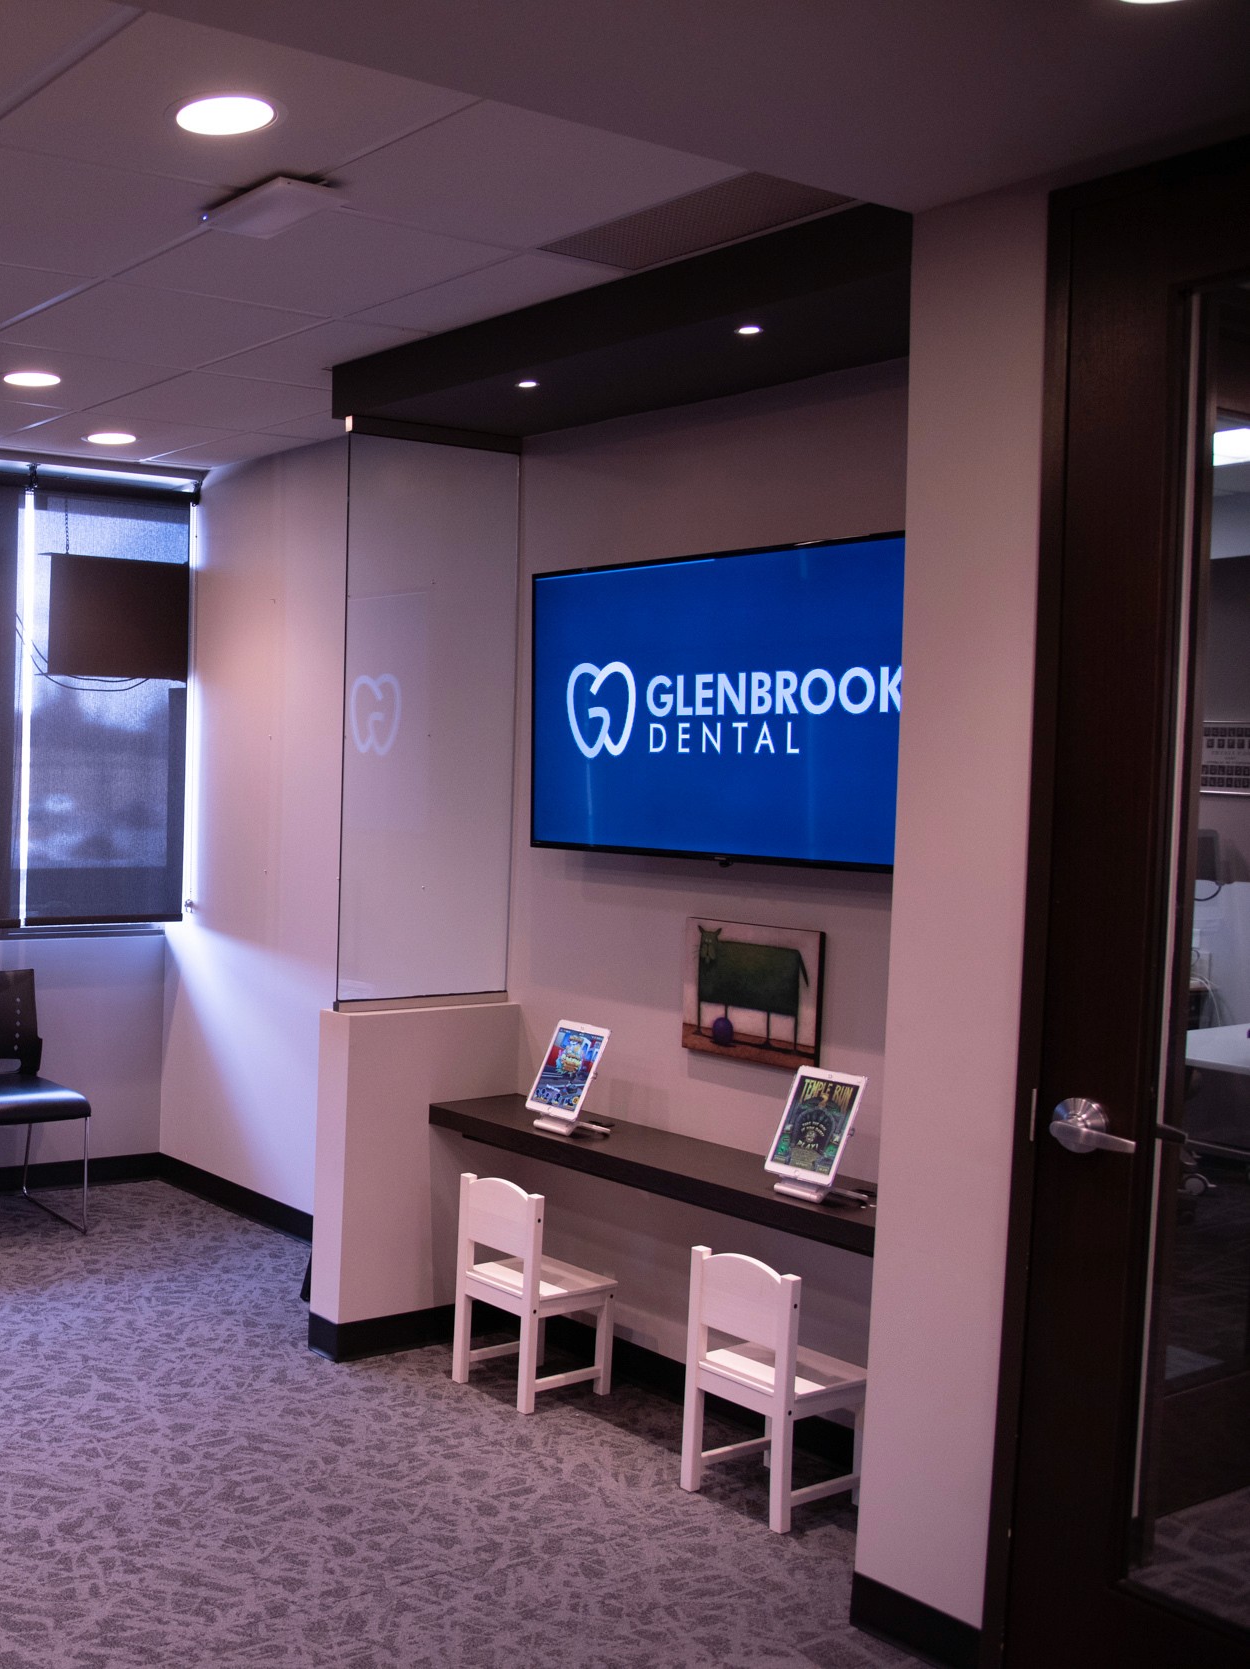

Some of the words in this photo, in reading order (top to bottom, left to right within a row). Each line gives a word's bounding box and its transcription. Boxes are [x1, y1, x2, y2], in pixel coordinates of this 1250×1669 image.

[647, 666, 902, 717] GLENBROOK
[650, 722, 800, 754] DENTAL
[799, 1079, 833, 1103] TEMPLE
[832, 1085, 854, 1113] RUN
